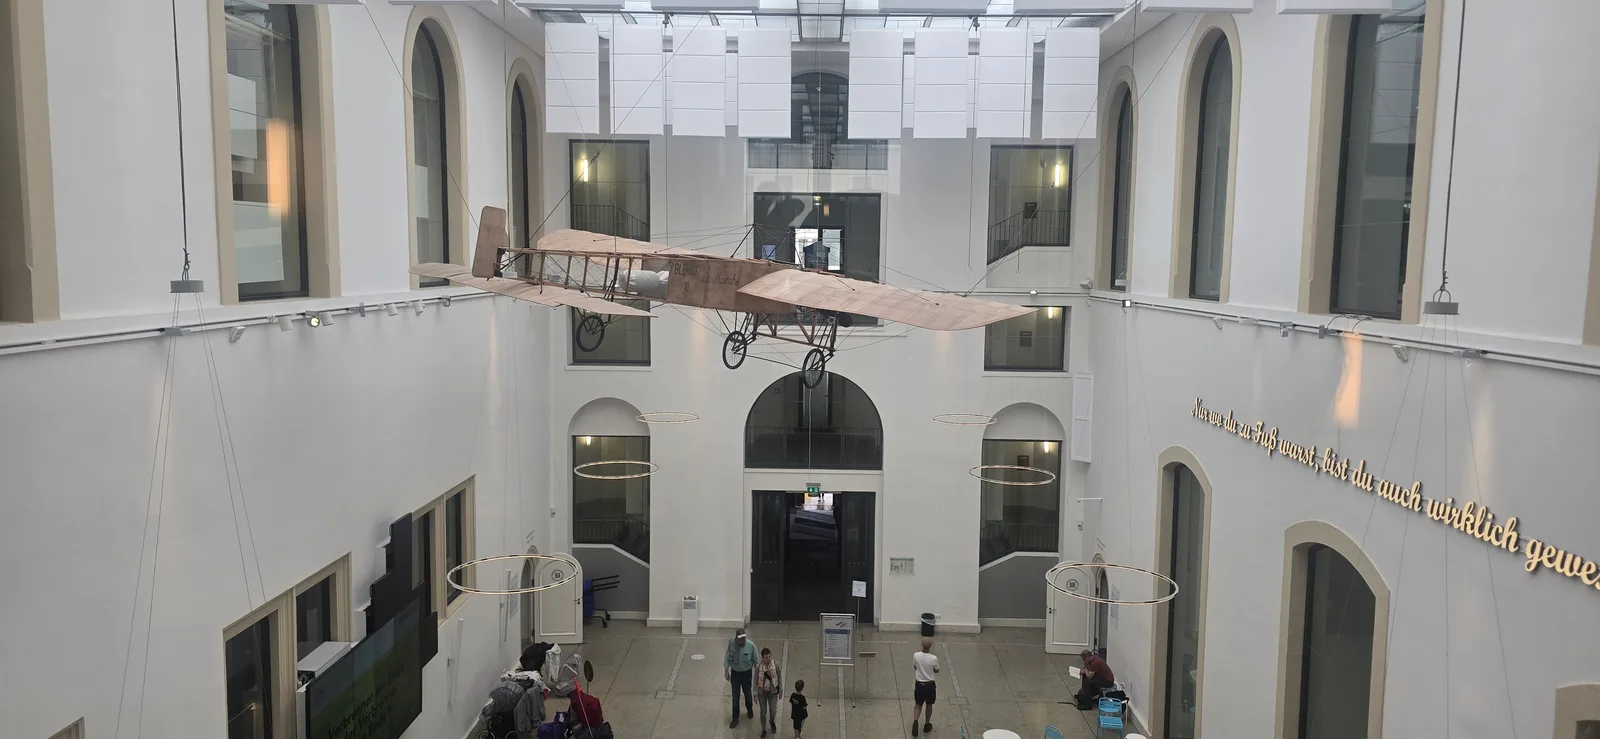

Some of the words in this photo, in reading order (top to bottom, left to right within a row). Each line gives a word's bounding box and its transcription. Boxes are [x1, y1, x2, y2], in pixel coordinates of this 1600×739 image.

[1191, 397, 1208, 421] Nur
[1210, 409, 1222, 427] wo
[1224, 410, 1237, 433] du
[1239, 422, 1251, 439] zu
[1253, 420, 1278, 456] Fuß
[1279, 438, 1319, 473] warst,
[1322, 447, 1348, 481] bist
[1352, 460, 1375, 491] du
[1377, 480, 1422, 512] auch
[1426, 497, 1519, 553] wirklich
